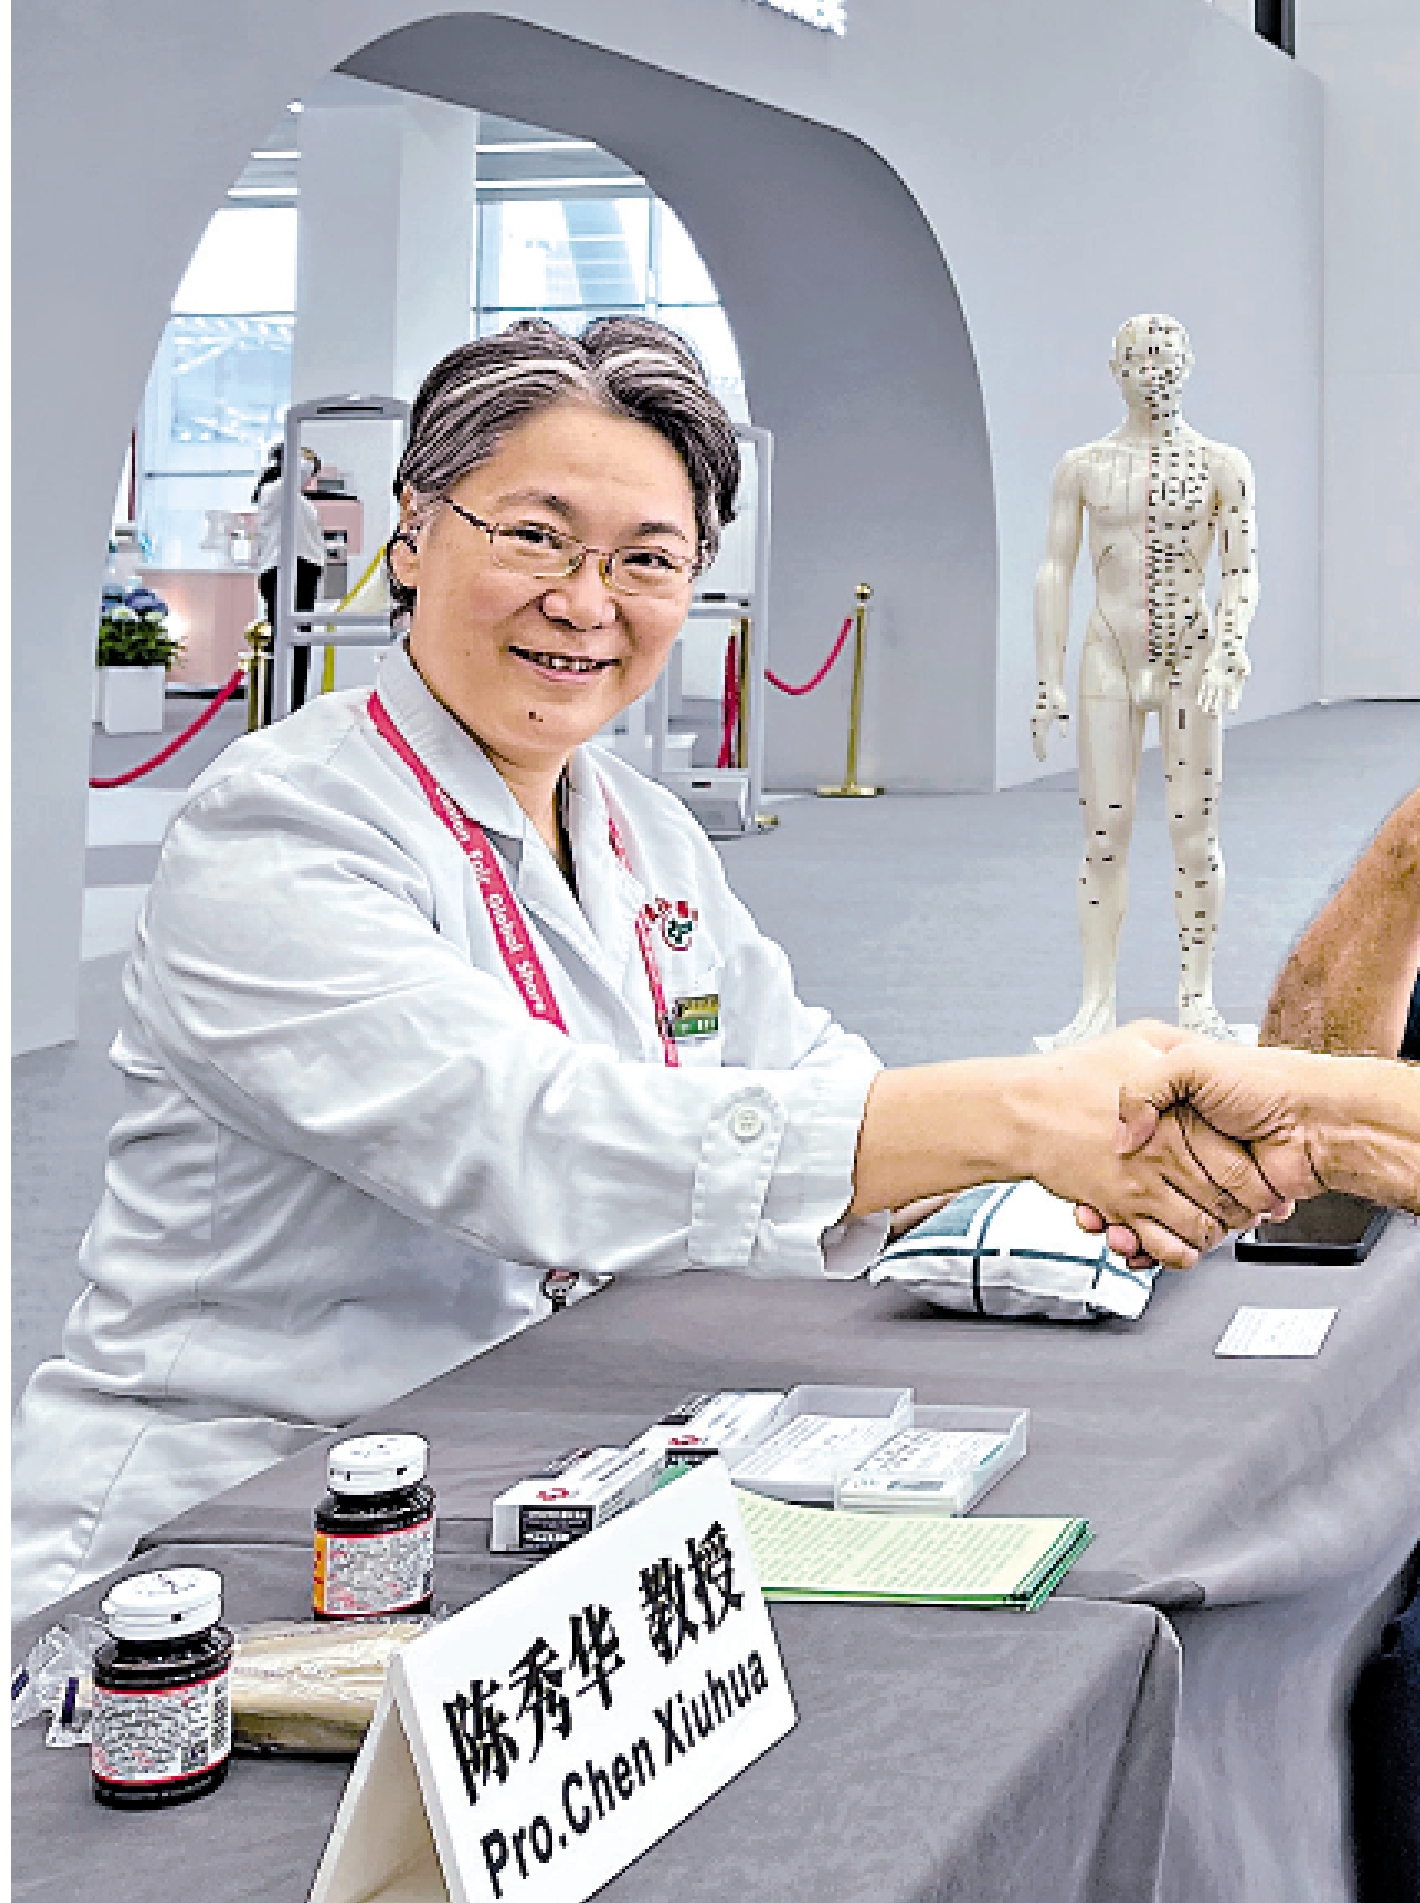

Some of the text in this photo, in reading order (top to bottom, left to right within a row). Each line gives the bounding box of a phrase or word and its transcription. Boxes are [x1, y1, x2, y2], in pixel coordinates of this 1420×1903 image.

[489, 894, 523, 953] Global
[515, 961, 546, 1010] Share
[443, 1604, 625, 1806] 陈秀华
[638, 1520, 744, 1667] 教授
[652, 1650, 770, 1766] Xiuhua
